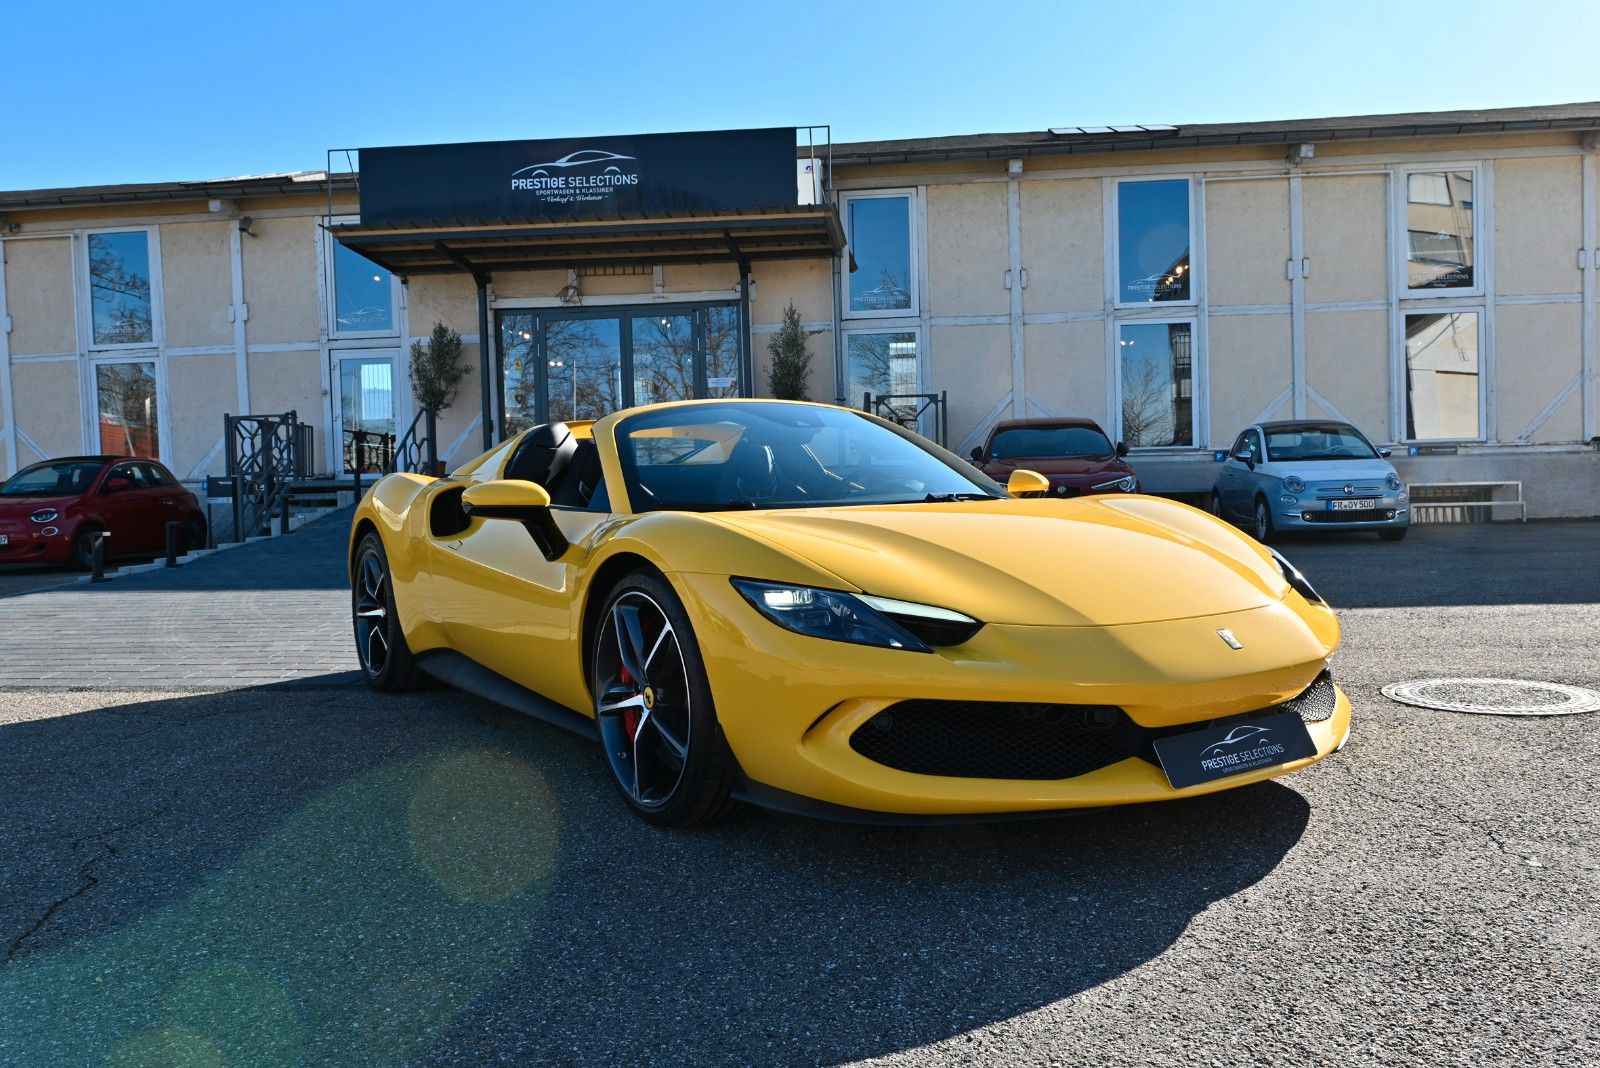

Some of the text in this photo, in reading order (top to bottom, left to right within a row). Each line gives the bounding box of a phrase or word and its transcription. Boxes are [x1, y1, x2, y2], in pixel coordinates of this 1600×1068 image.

[511, 174, 639, 190] PRESTIGE SELECTIONS
[581, 186, 614, 194] KLASSIKER
[1201, 743, 1285, 771] PRESTIGE SELECTIONS
